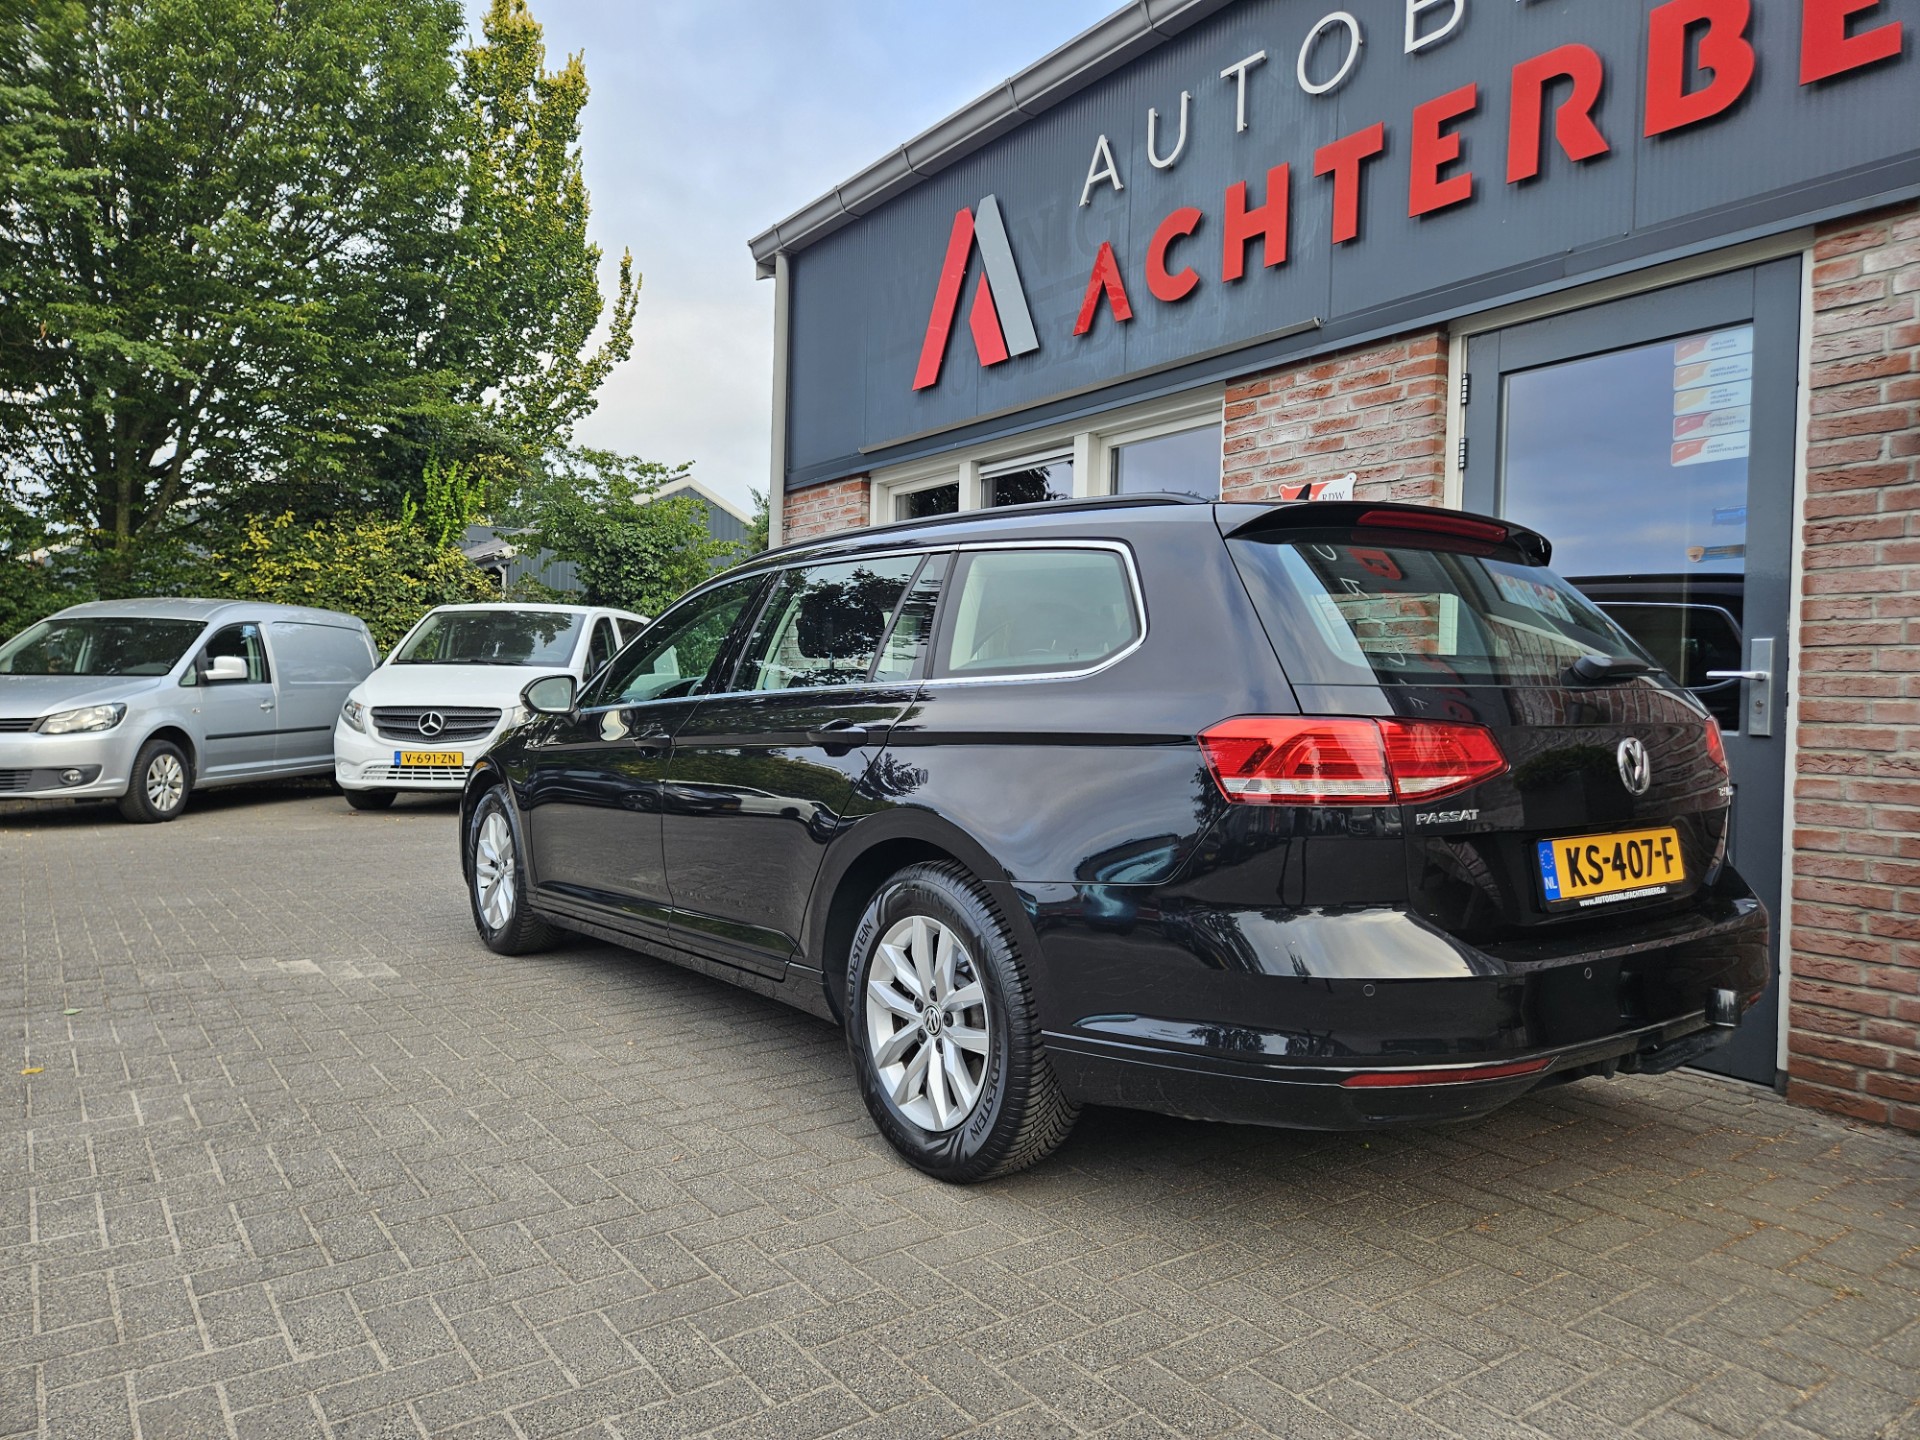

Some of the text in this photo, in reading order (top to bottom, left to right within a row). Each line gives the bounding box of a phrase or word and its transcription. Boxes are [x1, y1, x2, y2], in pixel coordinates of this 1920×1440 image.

[1078, 0, 1520, 206] AUTOB
[404, 753, 457, 765] V-691-ZN
[1416, 808, 1480, 825] PASSAT
[1566, 836, 1674, 888] KS-407-F
[1543, 876, 1558, 890] NL
